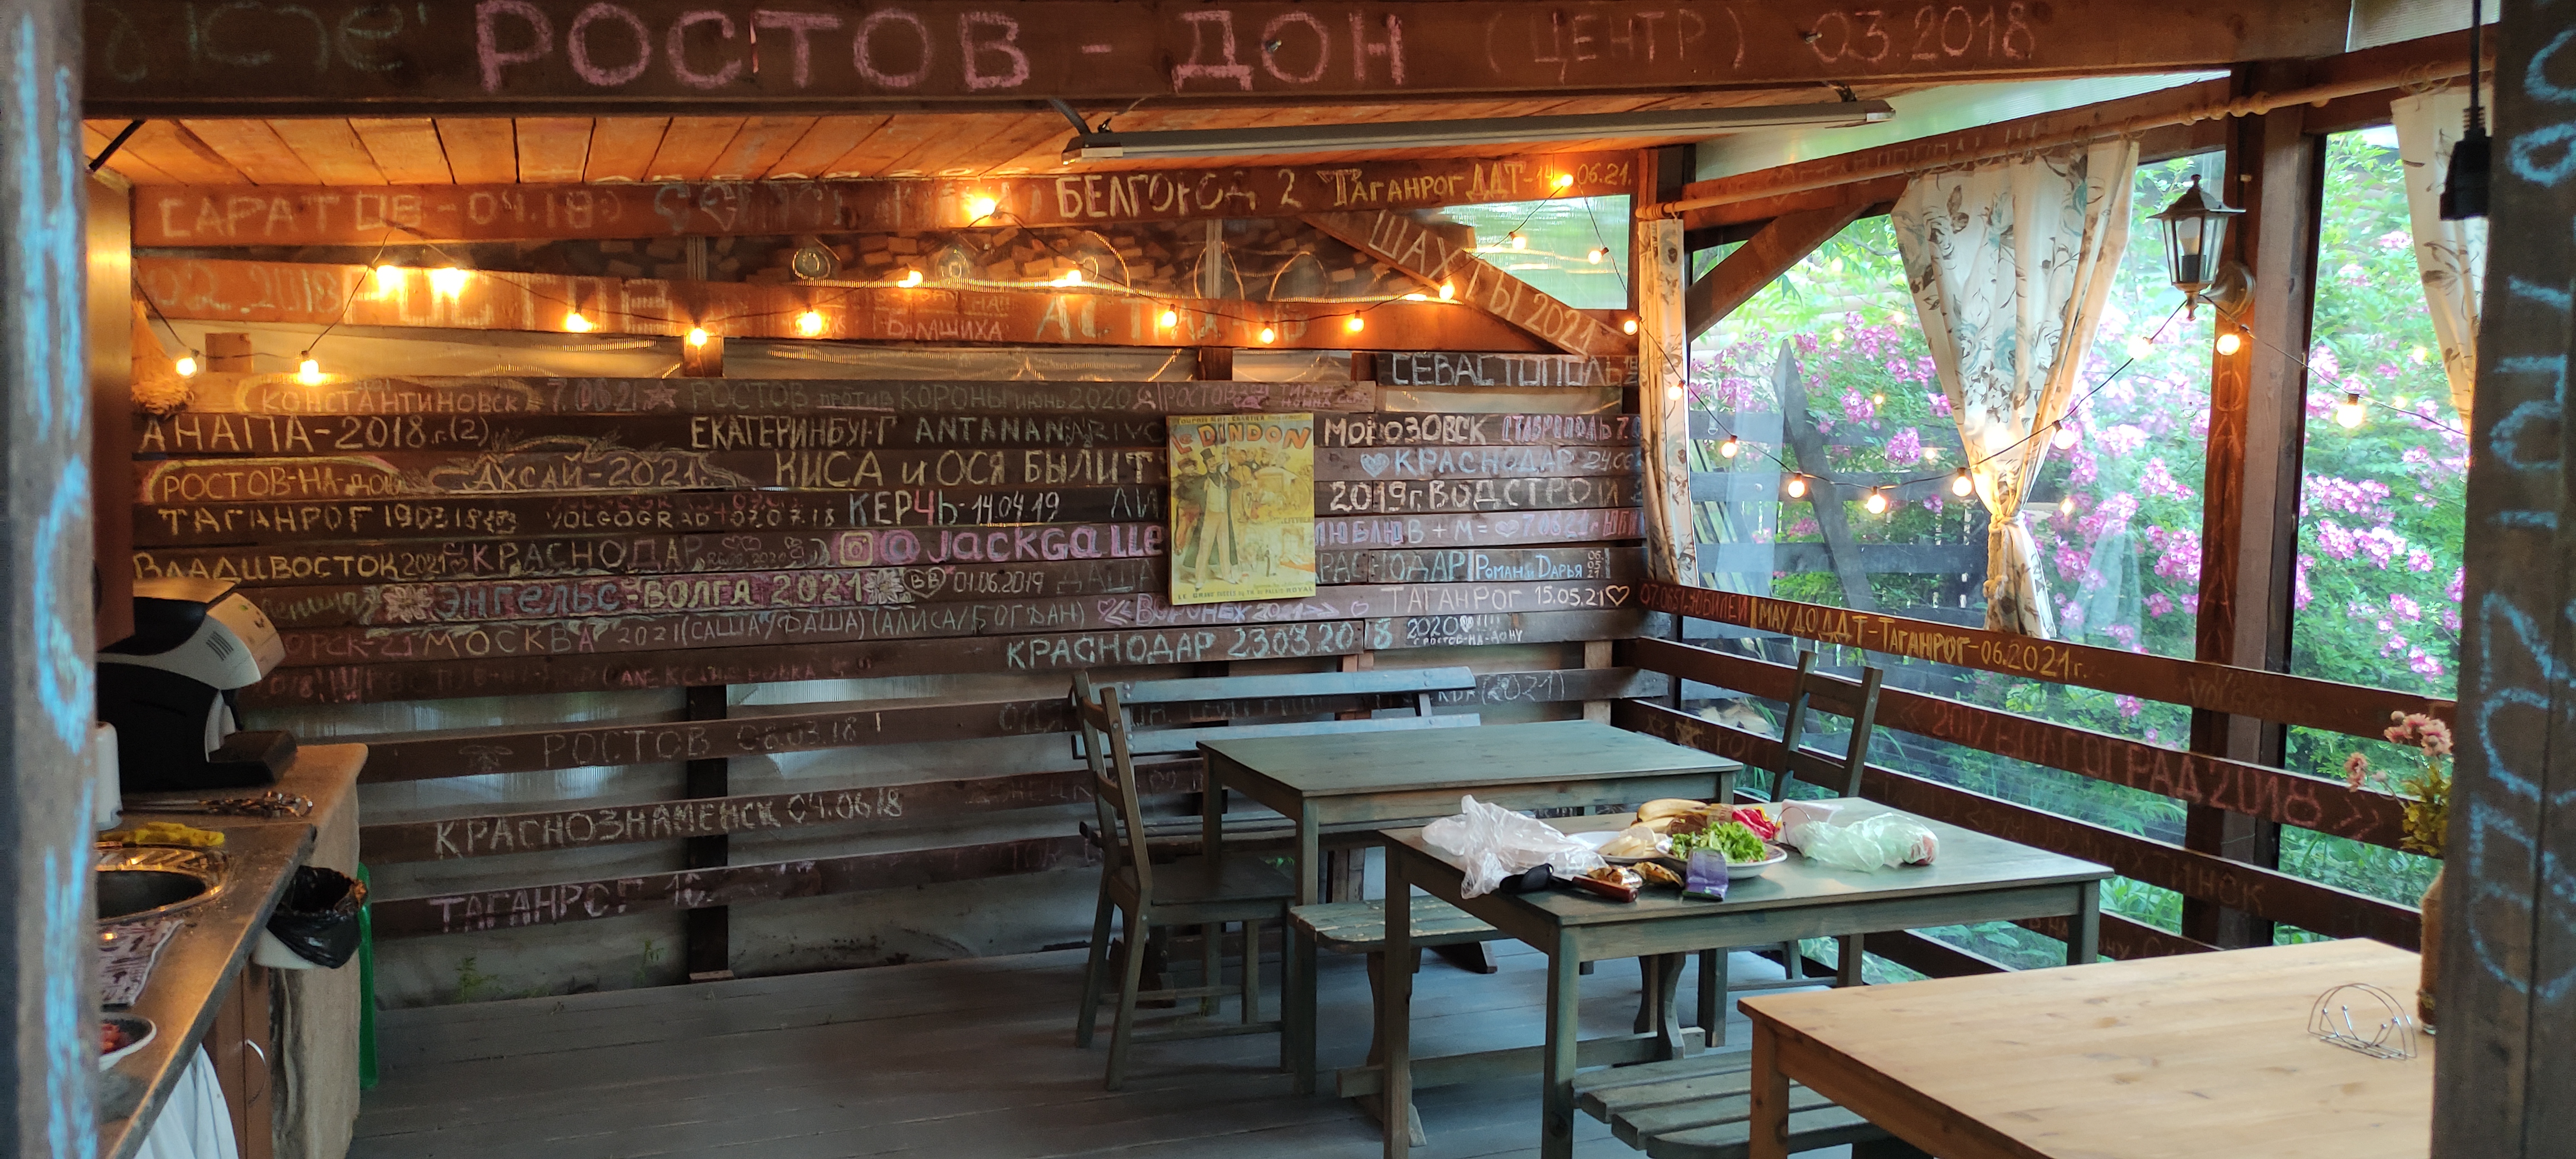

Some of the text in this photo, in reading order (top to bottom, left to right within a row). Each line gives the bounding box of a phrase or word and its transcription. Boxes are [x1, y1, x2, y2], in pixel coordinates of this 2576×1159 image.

[475, 1, 1030, 92] РОСТОВ
[1172, 9, 1406, 92] ДОН
[1812, 3, 2036, 66] 03.2018
[1277, 168, 1303, 209] 2
[1368, 209, 1600, 356] ШАХТЫ 2021
[1393, 353, 1623, 387] СЕВАСТОПОЛЬ
[262, 388, 519, 413] КОНСТАНТИНОВСК
[690, 382, 809, 411] РОСТОВ
[1066, 384, 1131, 410] 2020
[1197, 424, 1313, 450] DINDON
[774, 449, 884, 488] КИСА
[936, 449, 1003, 486] ОСЯ
[1394, 448, 1574, 476] КРАСНОДАР
[158, 506, 372, 535] ТАГАНРОГ
[547, 510, 710, 529] VOLGOGRAD
[133, 551, 445, 584] ВЛАДИВОСТОК 2021
[472, 537, 702, 573] КРАСНОДАР
[1316, 549, 1466, 585] РАСНОДАР
[772, 571, 862, 607] 2021
[953, 571, 1045, 595] 01.06.2019
[1057, 559, 1157, 595] ДАША
[1380, 584, 1605, 613] ТАГАНРОГ 15.05.21
[1759, 600, 1792, 631] МАУ
[423, 625, 595, 658] МОСКВА
[1407, 616, 1460, 640] 2020
[1006, 629, 1217, 670] КРАСНОДАР
[543, 727, 710, 768] РОСТОВ
[2207, 762, 2323, 828] 2018
[435, 798, 782, 859] КРАСНОЗНАМЕНСК
[427, 878, 644, 933] ТАГАНРОГ
